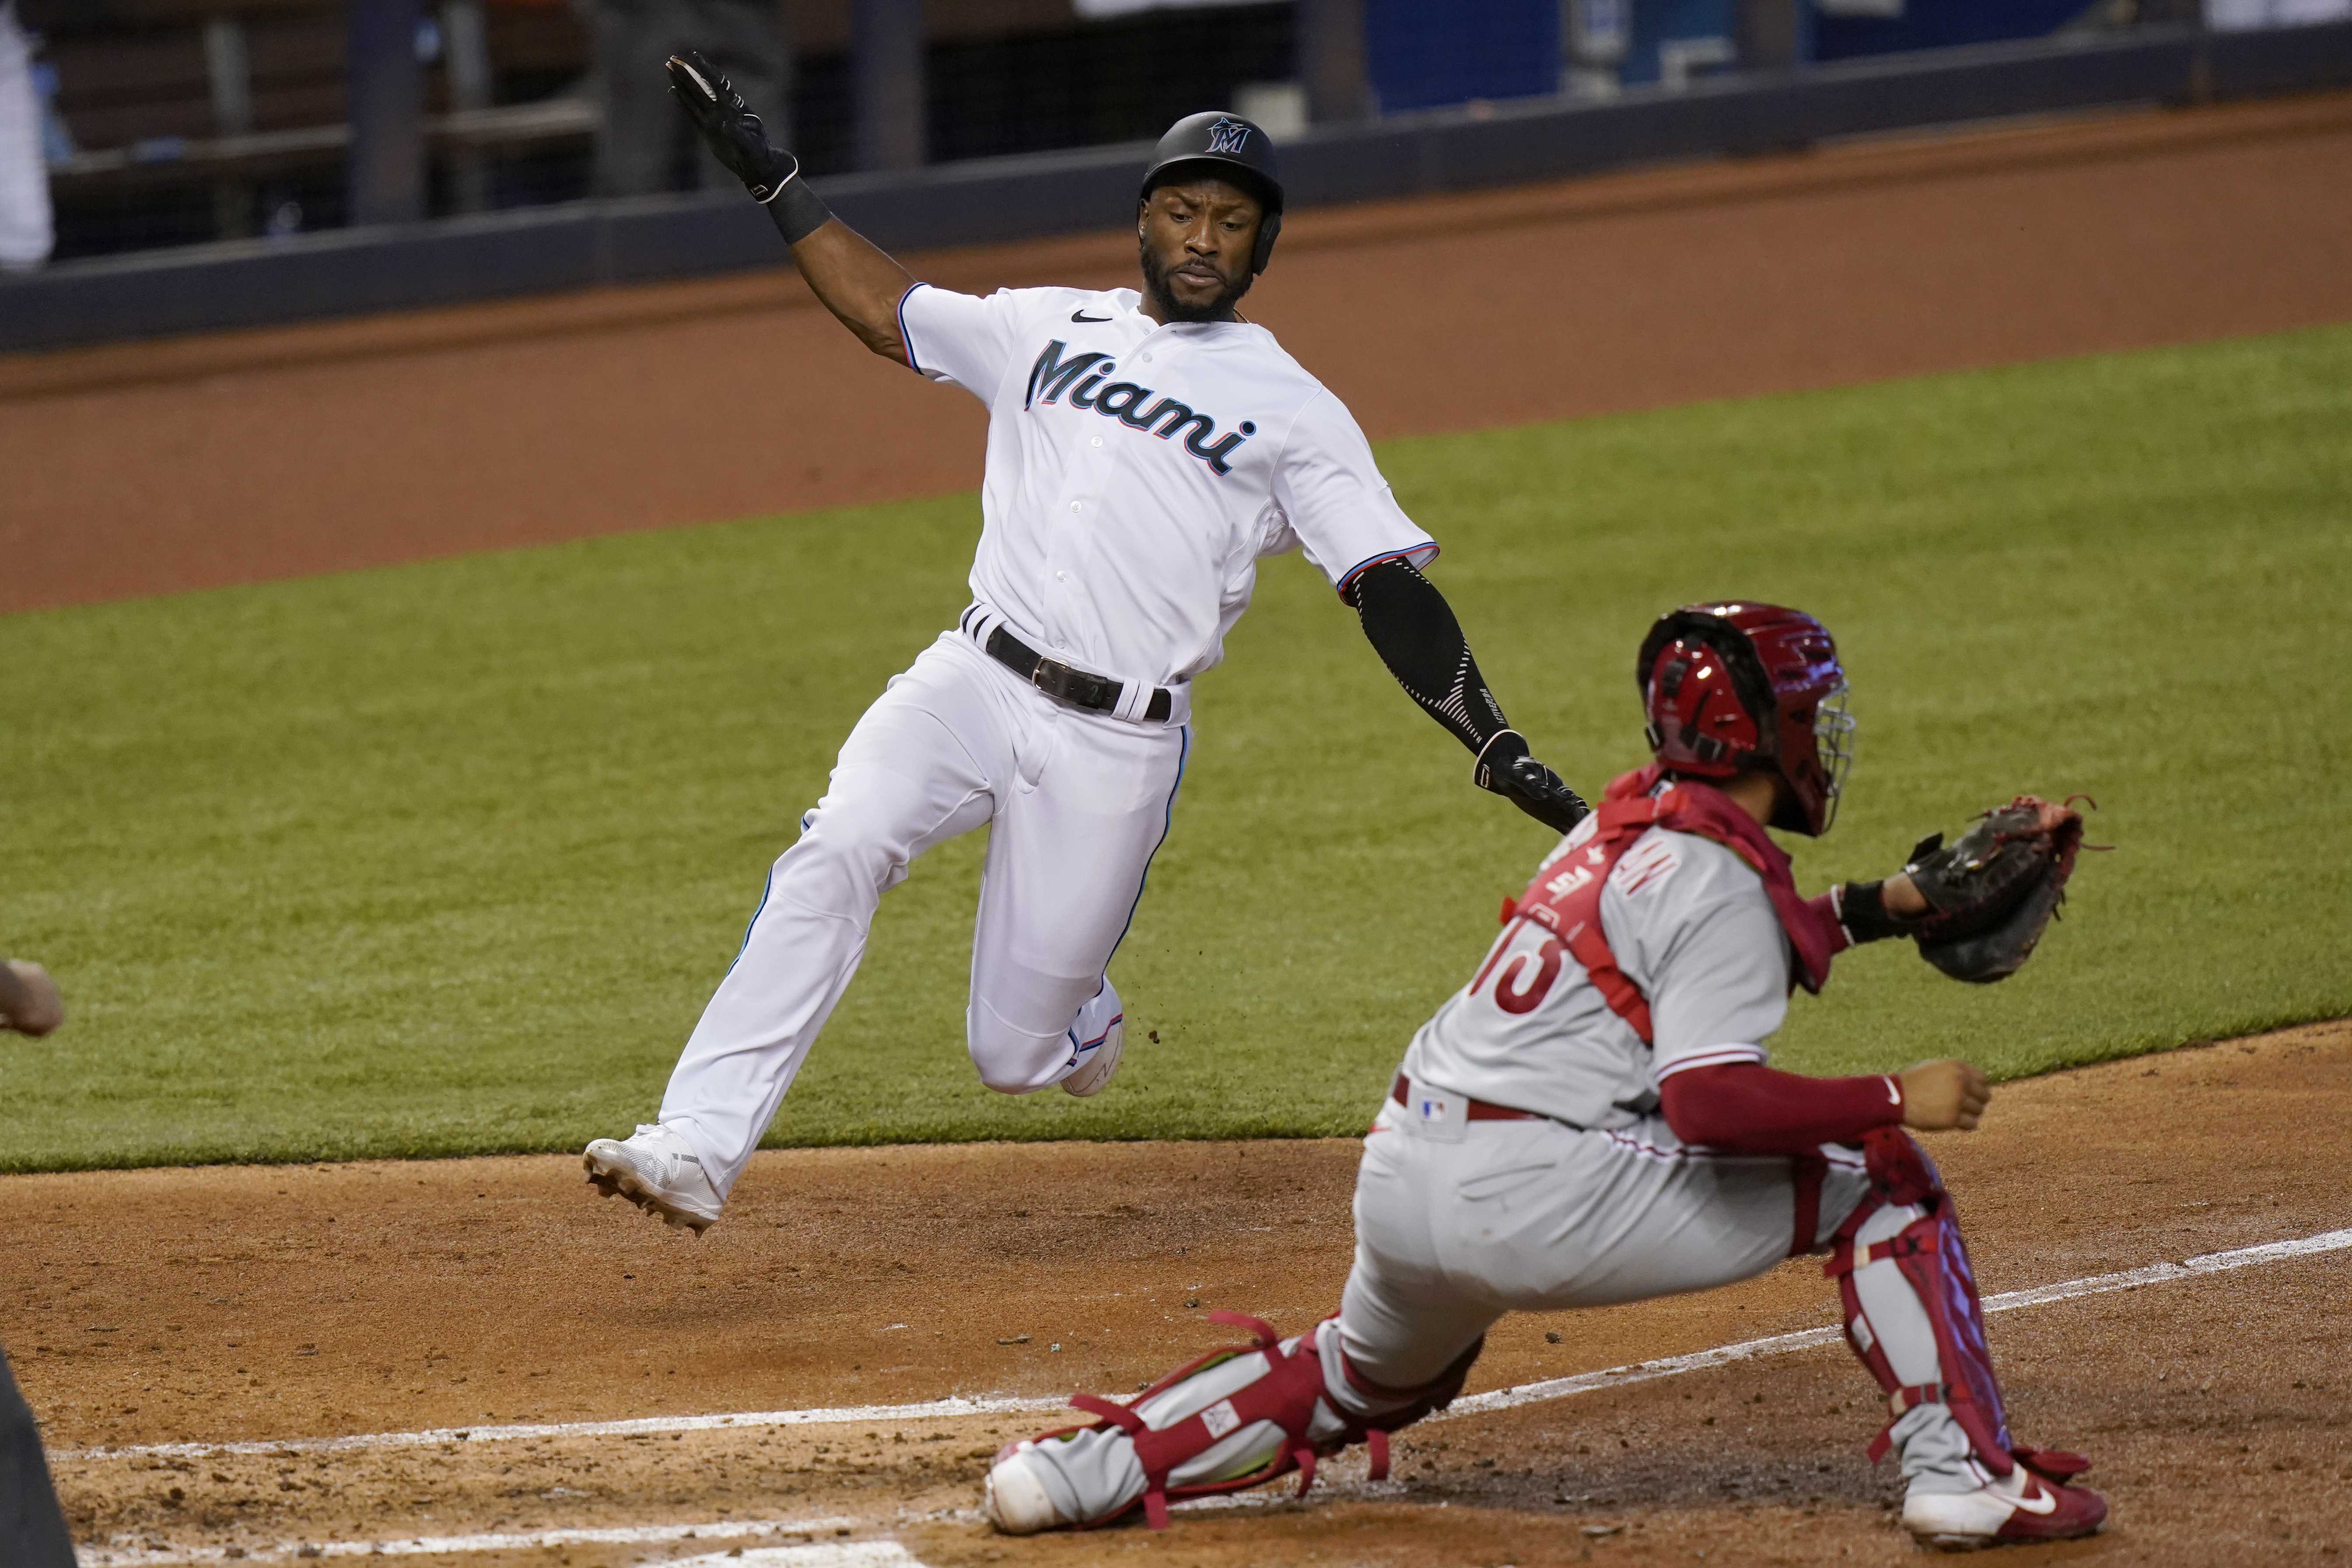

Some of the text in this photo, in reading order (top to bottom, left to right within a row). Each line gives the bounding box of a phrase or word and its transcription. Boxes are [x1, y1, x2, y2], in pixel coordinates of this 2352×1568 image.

[1206, 127, 1252, 154] M
[1024, 339, 1256, 476] Miami
[1086, 684, 1099, 703] 2
